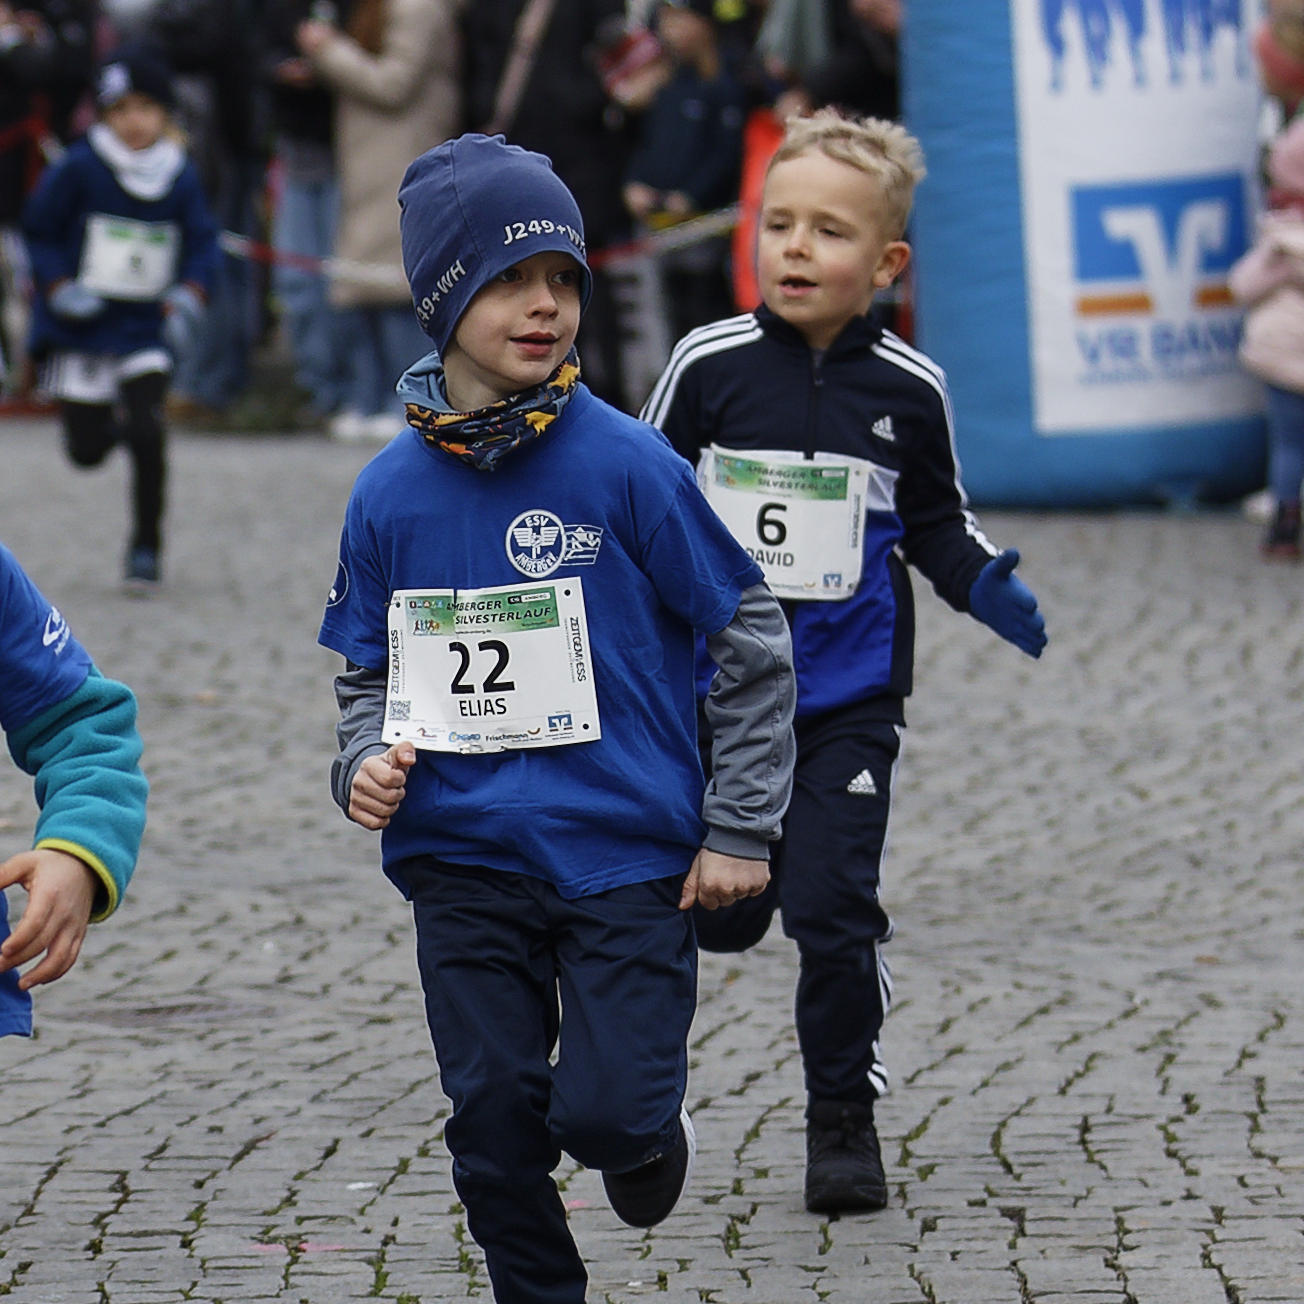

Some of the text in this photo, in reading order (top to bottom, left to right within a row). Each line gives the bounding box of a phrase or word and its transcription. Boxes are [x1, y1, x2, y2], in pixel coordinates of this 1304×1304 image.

[1076, 327, 1140, 367] VR
[524, 515, 549, 528] ESV
[756, 502, 787, 546] 6
[455, 607, 553, 625] SILVESTERLAUF
[448, 639, 516, 695] 22
[459, 697, 507, 717] ELIAS
[485, 733, 528, 742] Frischmann
